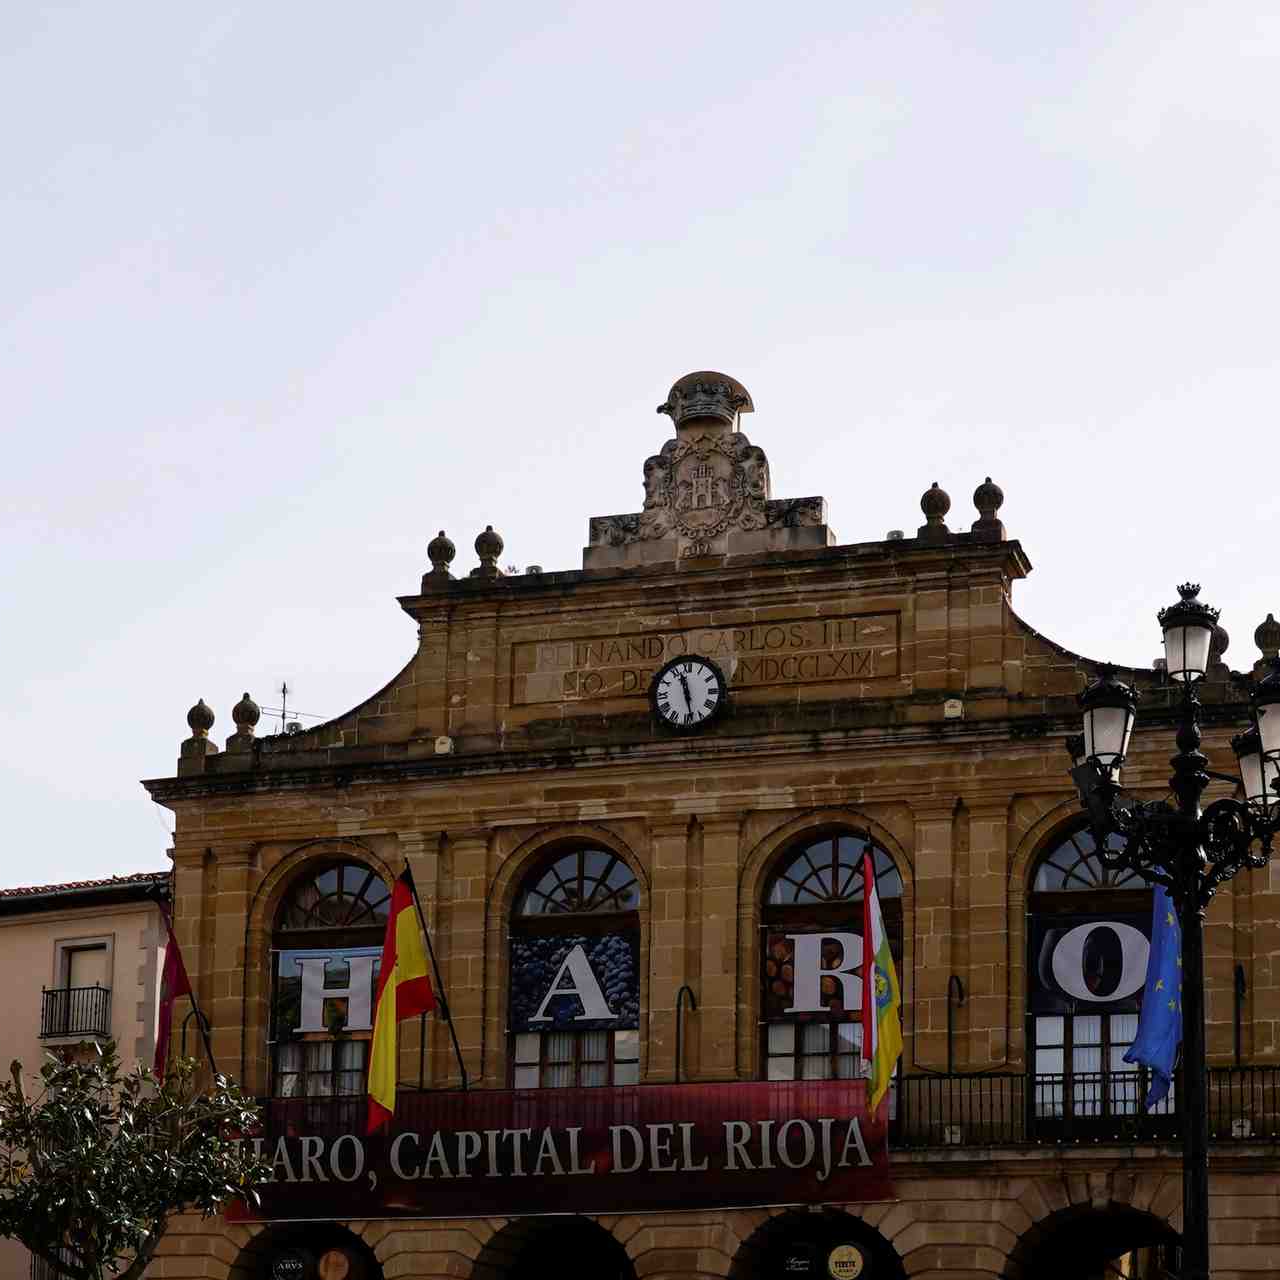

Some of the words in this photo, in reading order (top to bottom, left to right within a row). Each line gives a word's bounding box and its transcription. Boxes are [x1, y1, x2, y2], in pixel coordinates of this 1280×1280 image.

[292, 956, 382, 1034] H
[527, 942, 618, 1023] A
[783, 932, 865, 1014] R
[1051, 921, 1151, 1002] O
[390, 1123, 596, 1181] CAPITAL
[609, 1121, 710, 1174] DEL
[724, 1114, 874, 1182] RIOJA
